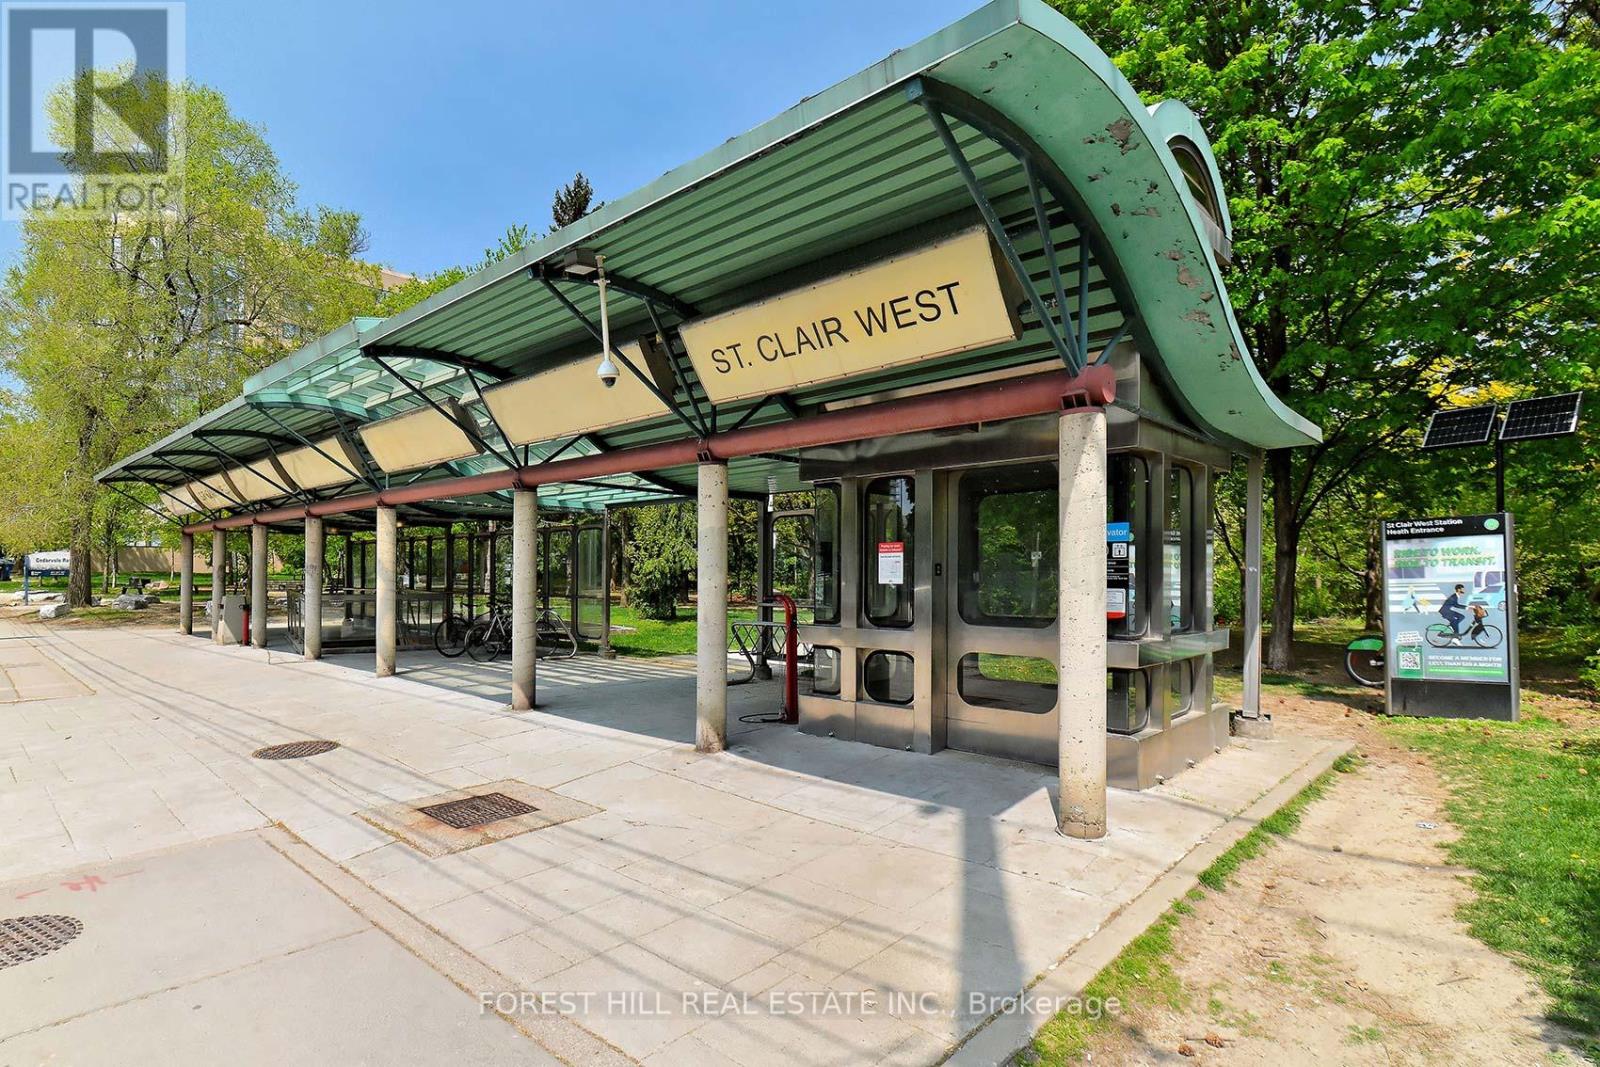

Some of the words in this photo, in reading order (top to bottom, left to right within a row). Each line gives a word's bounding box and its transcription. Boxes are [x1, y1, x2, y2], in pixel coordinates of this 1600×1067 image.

[711, 342, 753, 374] ST.
[756, 316, 849, 362] CLAIR
[853, 281, 960, 337] WEST
[1434, 518, 1463, 526] Station
[1411, 526, 1445, 534] Entrance
